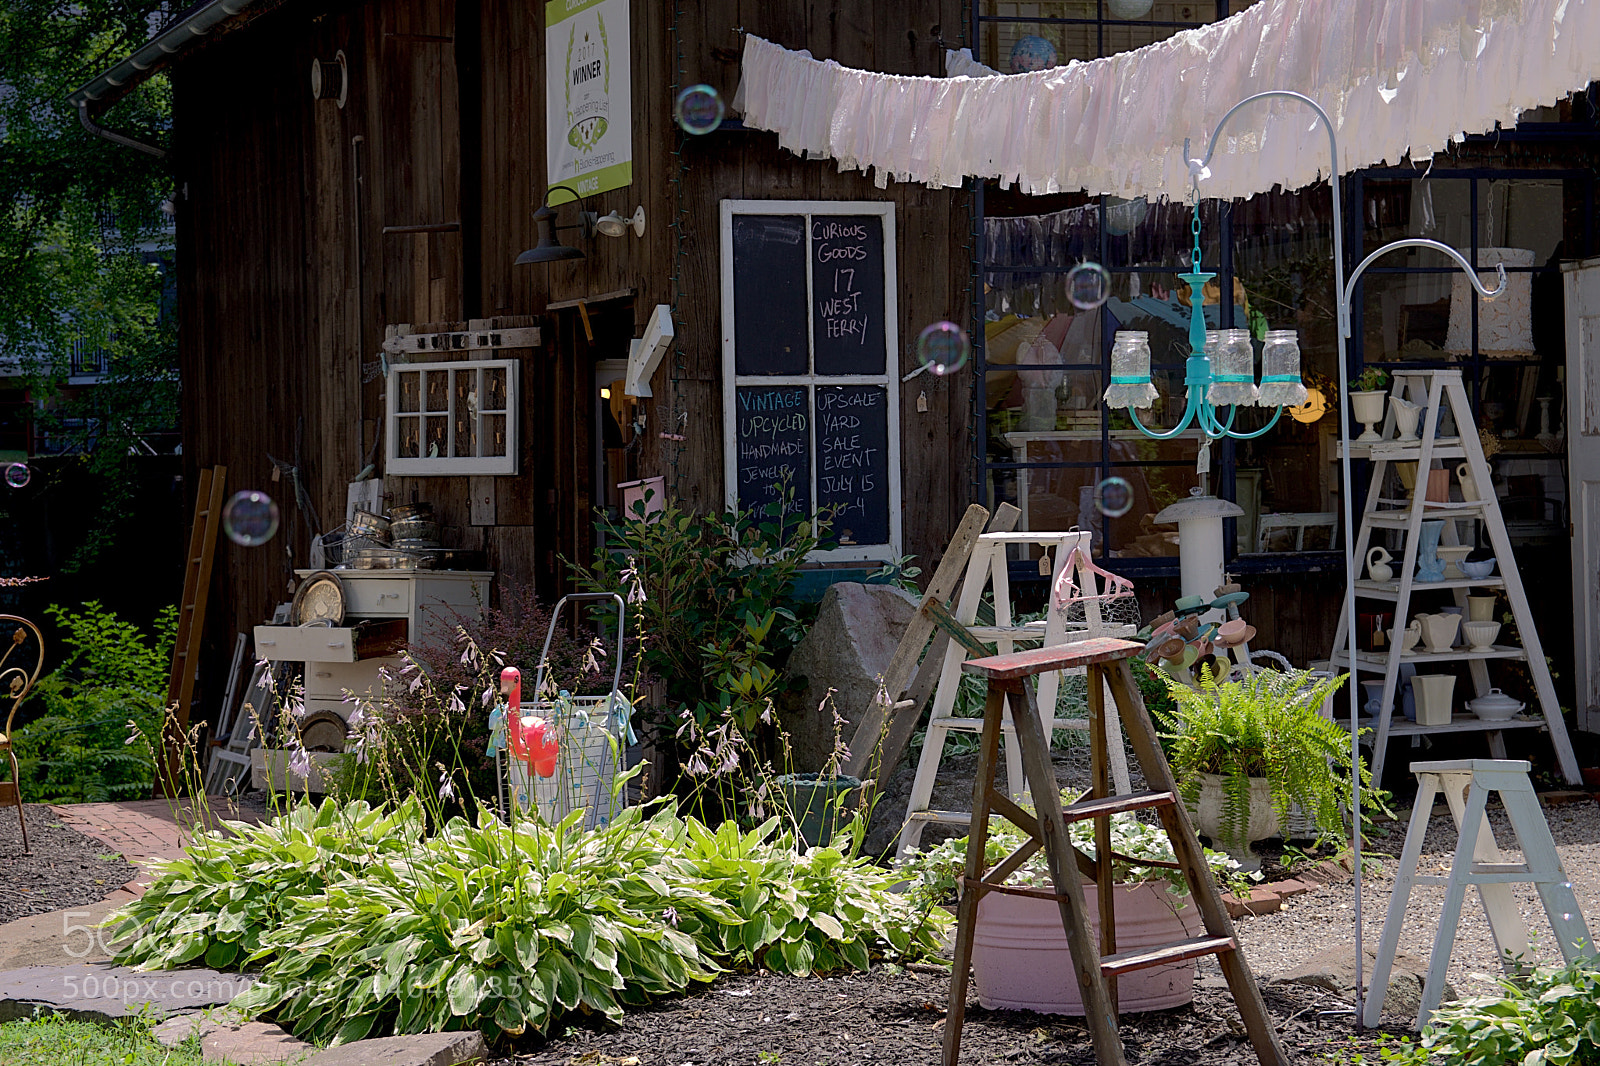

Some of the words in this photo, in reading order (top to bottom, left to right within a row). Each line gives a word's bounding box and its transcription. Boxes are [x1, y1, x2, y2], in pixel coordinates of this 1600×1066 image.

[572, 59, 601, 86] WINNER
[577, 176, 599, 194] VINTAGE
[818, 242, 867, 263] GOODS
[834, 268, 855, 293] 17
[820, 291, 861, 318] WEST
[827, 313, 867, 345] FERRY
[817, 392, 881, 411] UPSCALE
[741, 413, 806, 440] UPCYCLED
[823, 413, 860, 435] YARD
[741, 438, 804, 460] HANDMADE
[822, 434, 860, 453] SALE
[823, 448, 877, 471] EVENT
[741, 463, 796, 484] JEWELRY
[820, 474, 853, 493] JULY
[861, 473, 874, 492] 15
